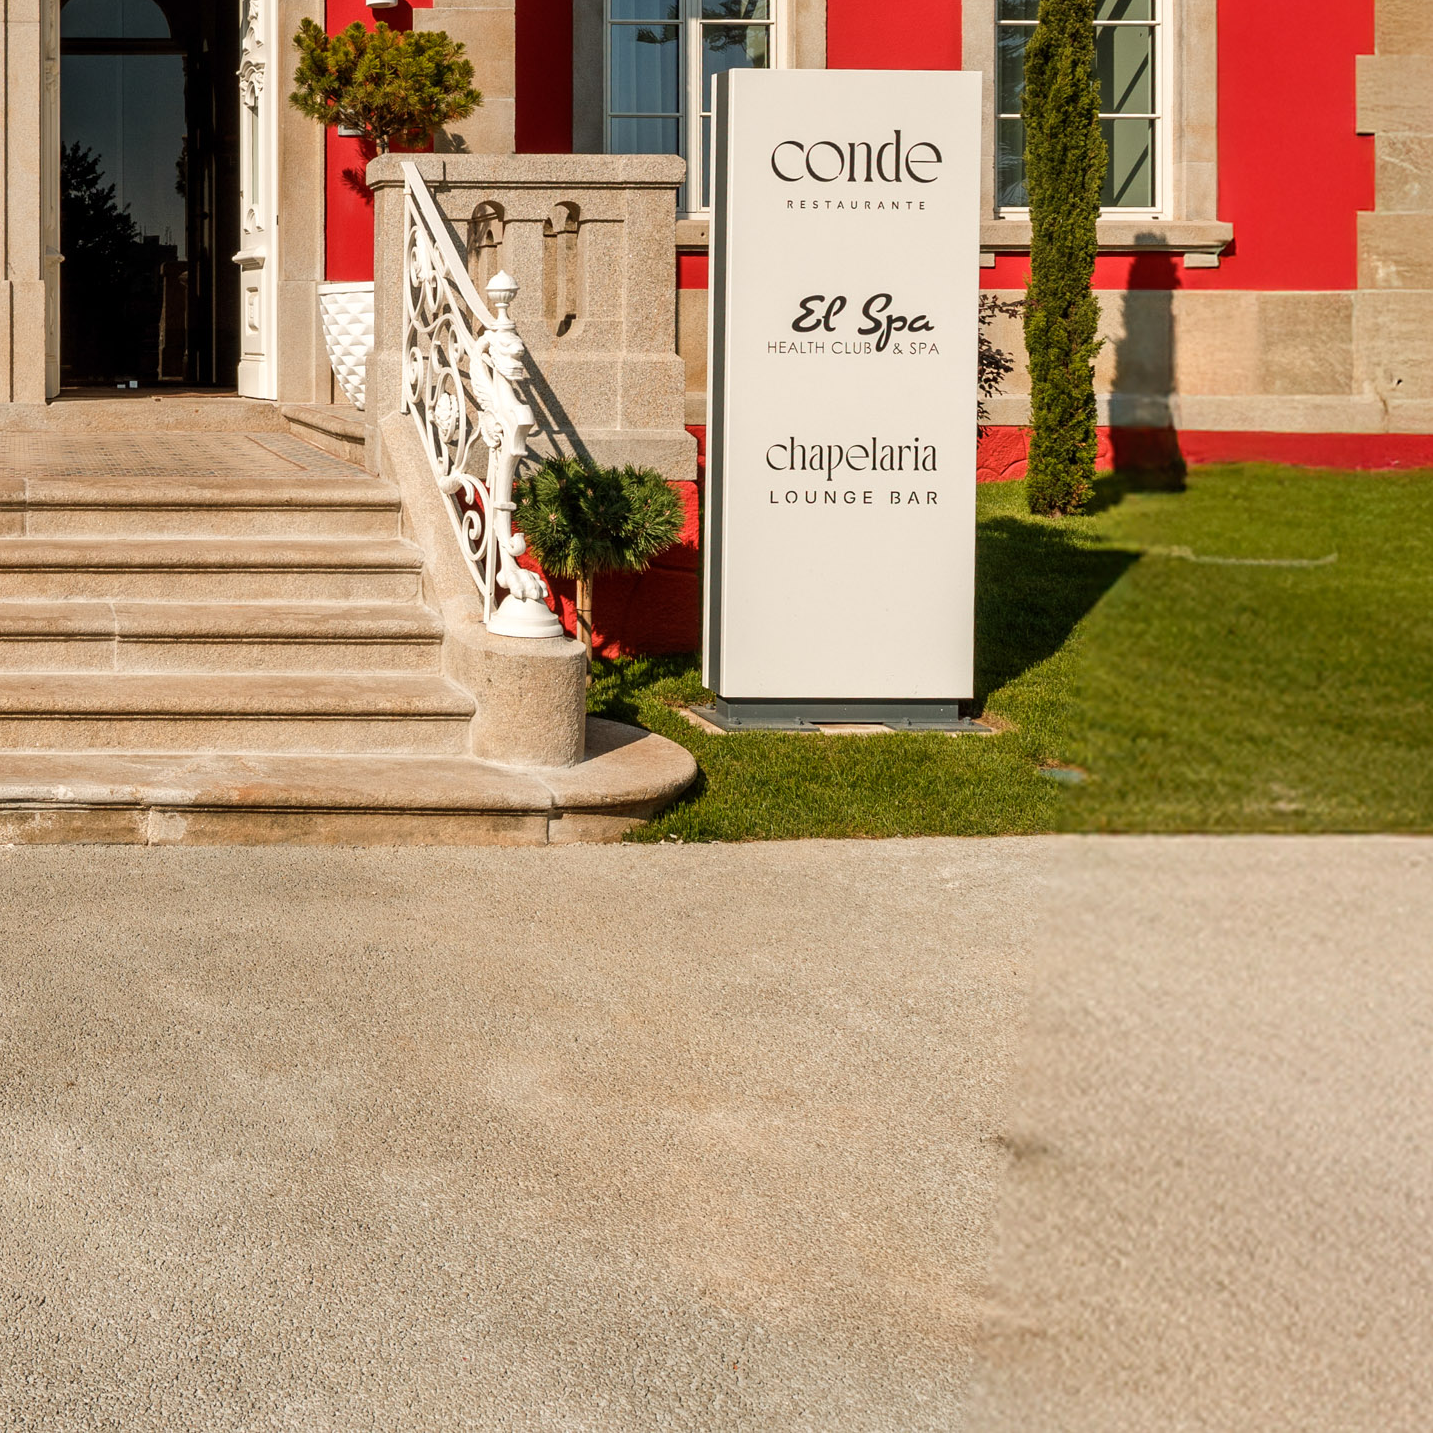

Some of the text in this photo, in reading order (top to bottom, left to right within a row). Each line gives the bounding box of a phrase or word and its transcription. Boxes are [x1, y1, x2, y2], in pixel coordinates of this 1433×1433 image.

[770, 129, 943, 184] conde
[787, 200, 926, 210] RESTAURANTE
[792, 293, 934, 353] El Spa
[767, 341, 940, 355] HEALTH CLUB & SPA
[766, 436, 937, 482] chapelaria
[770, 490, 938, 505] LOUNGE BAR
